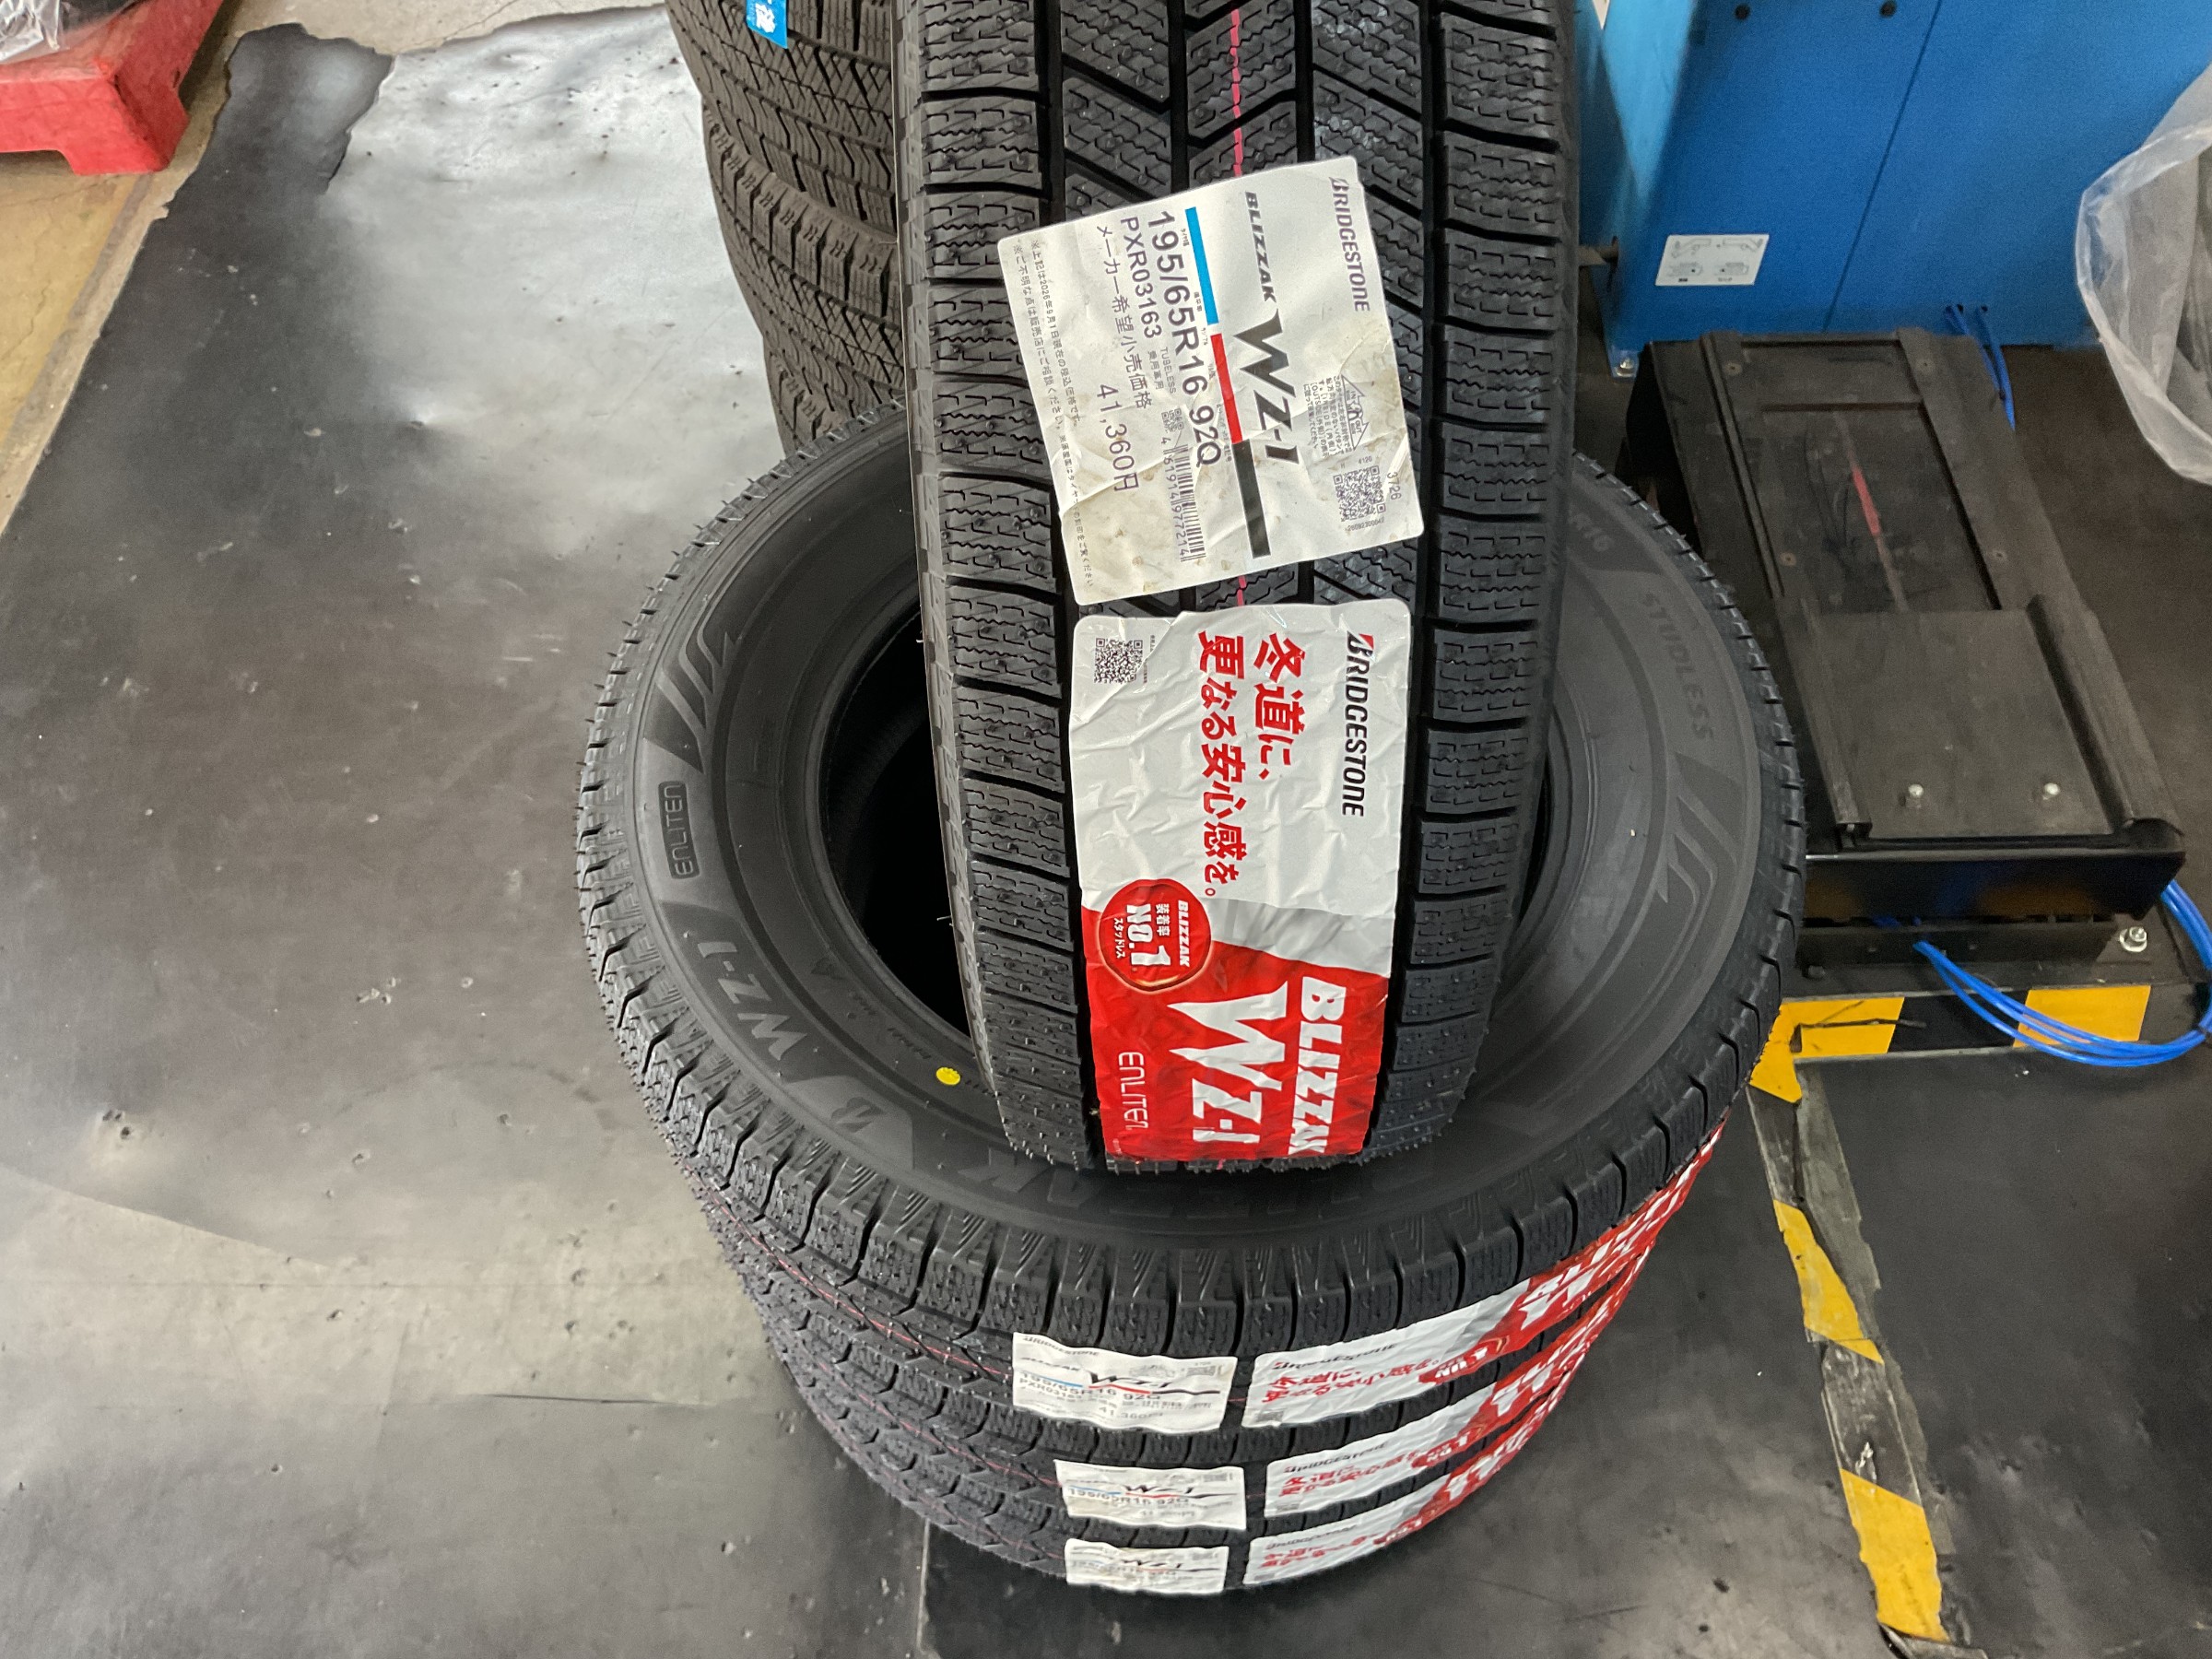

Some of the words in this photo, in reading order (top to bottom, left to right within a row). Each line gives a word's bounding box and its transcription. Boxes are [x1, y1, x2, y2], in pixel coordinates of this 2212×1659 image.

[1120, 216, 1161, 339] PXR03163
[1159, 347, 1176, 394] TUBELESS
[1245, 191, 1277, 303] BLIZZAK
[1330, 177, 1371, 312] BRIDGESTONE
[1095, 225, 1152, 410] メーカー希望小売価格
[1146, 209, 1208, 395] 195/65R16
[1188, 405, 1222, 467] 92Q
[1096, 383, 1138, 494] 41,360円
[1232, 310, 1300, 465] WZ-1
[1387, 471, 1402, 500] 3726
[1254, 633, 1306, 780] 冬道に、
[1341, 630, 1374, 816] BRIDGESTONE
[1641, 592, 1712, 743] STUDLESS
[662, 784, 694, 876] ENLITEN
[1198, 630, 1246, 898] 更なる安心感を。
[1113, 918, 1125, 959] スタッドレス
[1126, 904, 1171, 966] NO.1
[1156, 903, 1171, 936] 装着率
[1178, 900, 1190, 967] BLIZZAK
[697, 941, 808, 1061] WZ-1
[1167, 981, 1288, 1144] WZ-1
[1288, 976, 1347, 1156] BLIZZAK
[1118, 1052, 1148, 1130] ENLITEN
